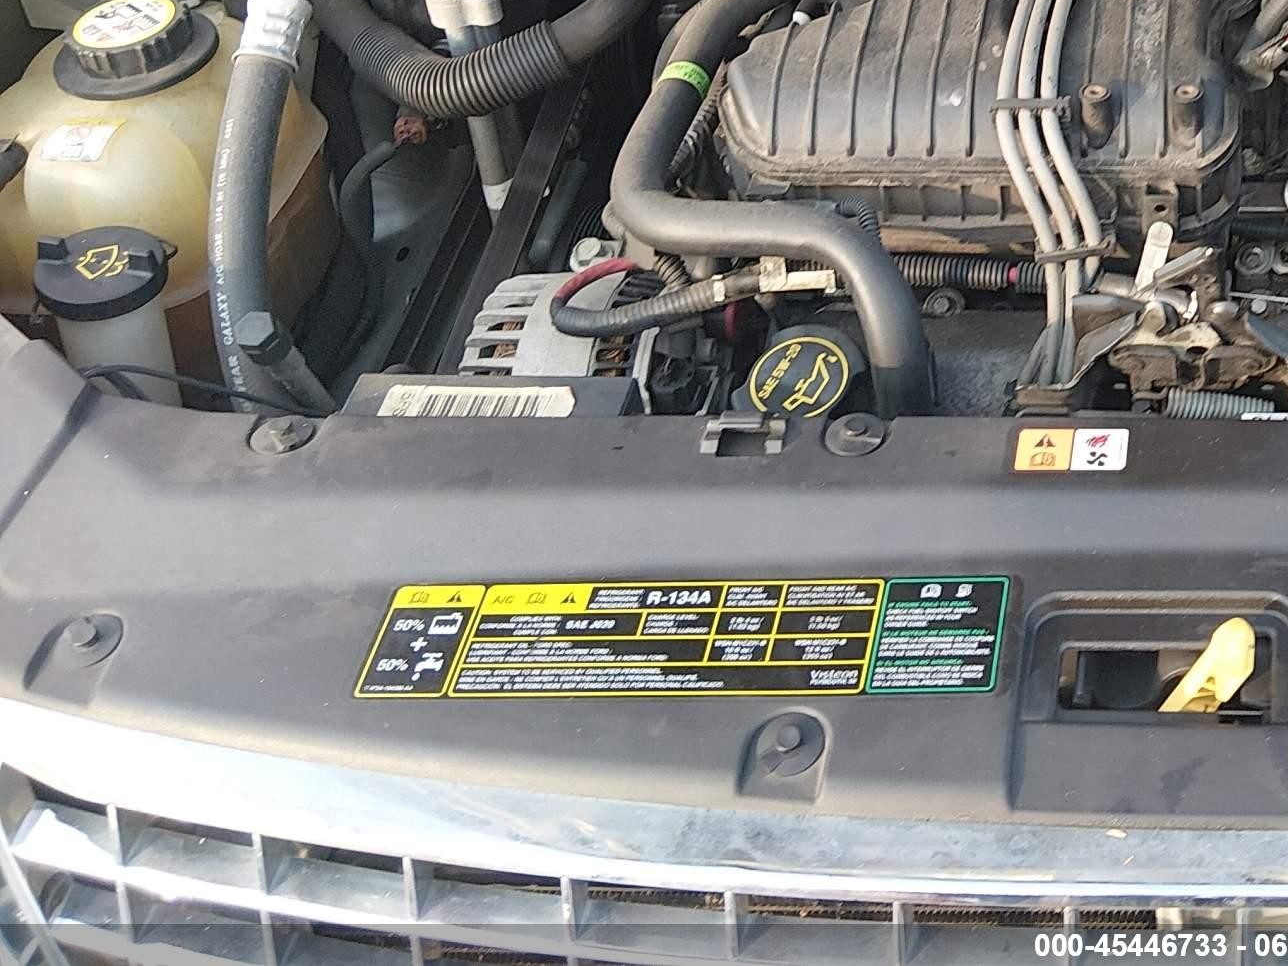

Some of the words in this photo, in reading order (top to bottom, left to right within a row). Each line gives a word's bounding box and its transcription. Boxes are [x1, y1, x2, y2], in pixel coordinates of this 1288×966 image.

[757, 375, 780, 400] SAE
[492, 595, 515, 604] A/C
[646, 590, 712, 606] R-134A
[392, 619, 426, 632] 50%
[565, 620, 587, 630] SAE
[375, 658, 409, 672] 50%
